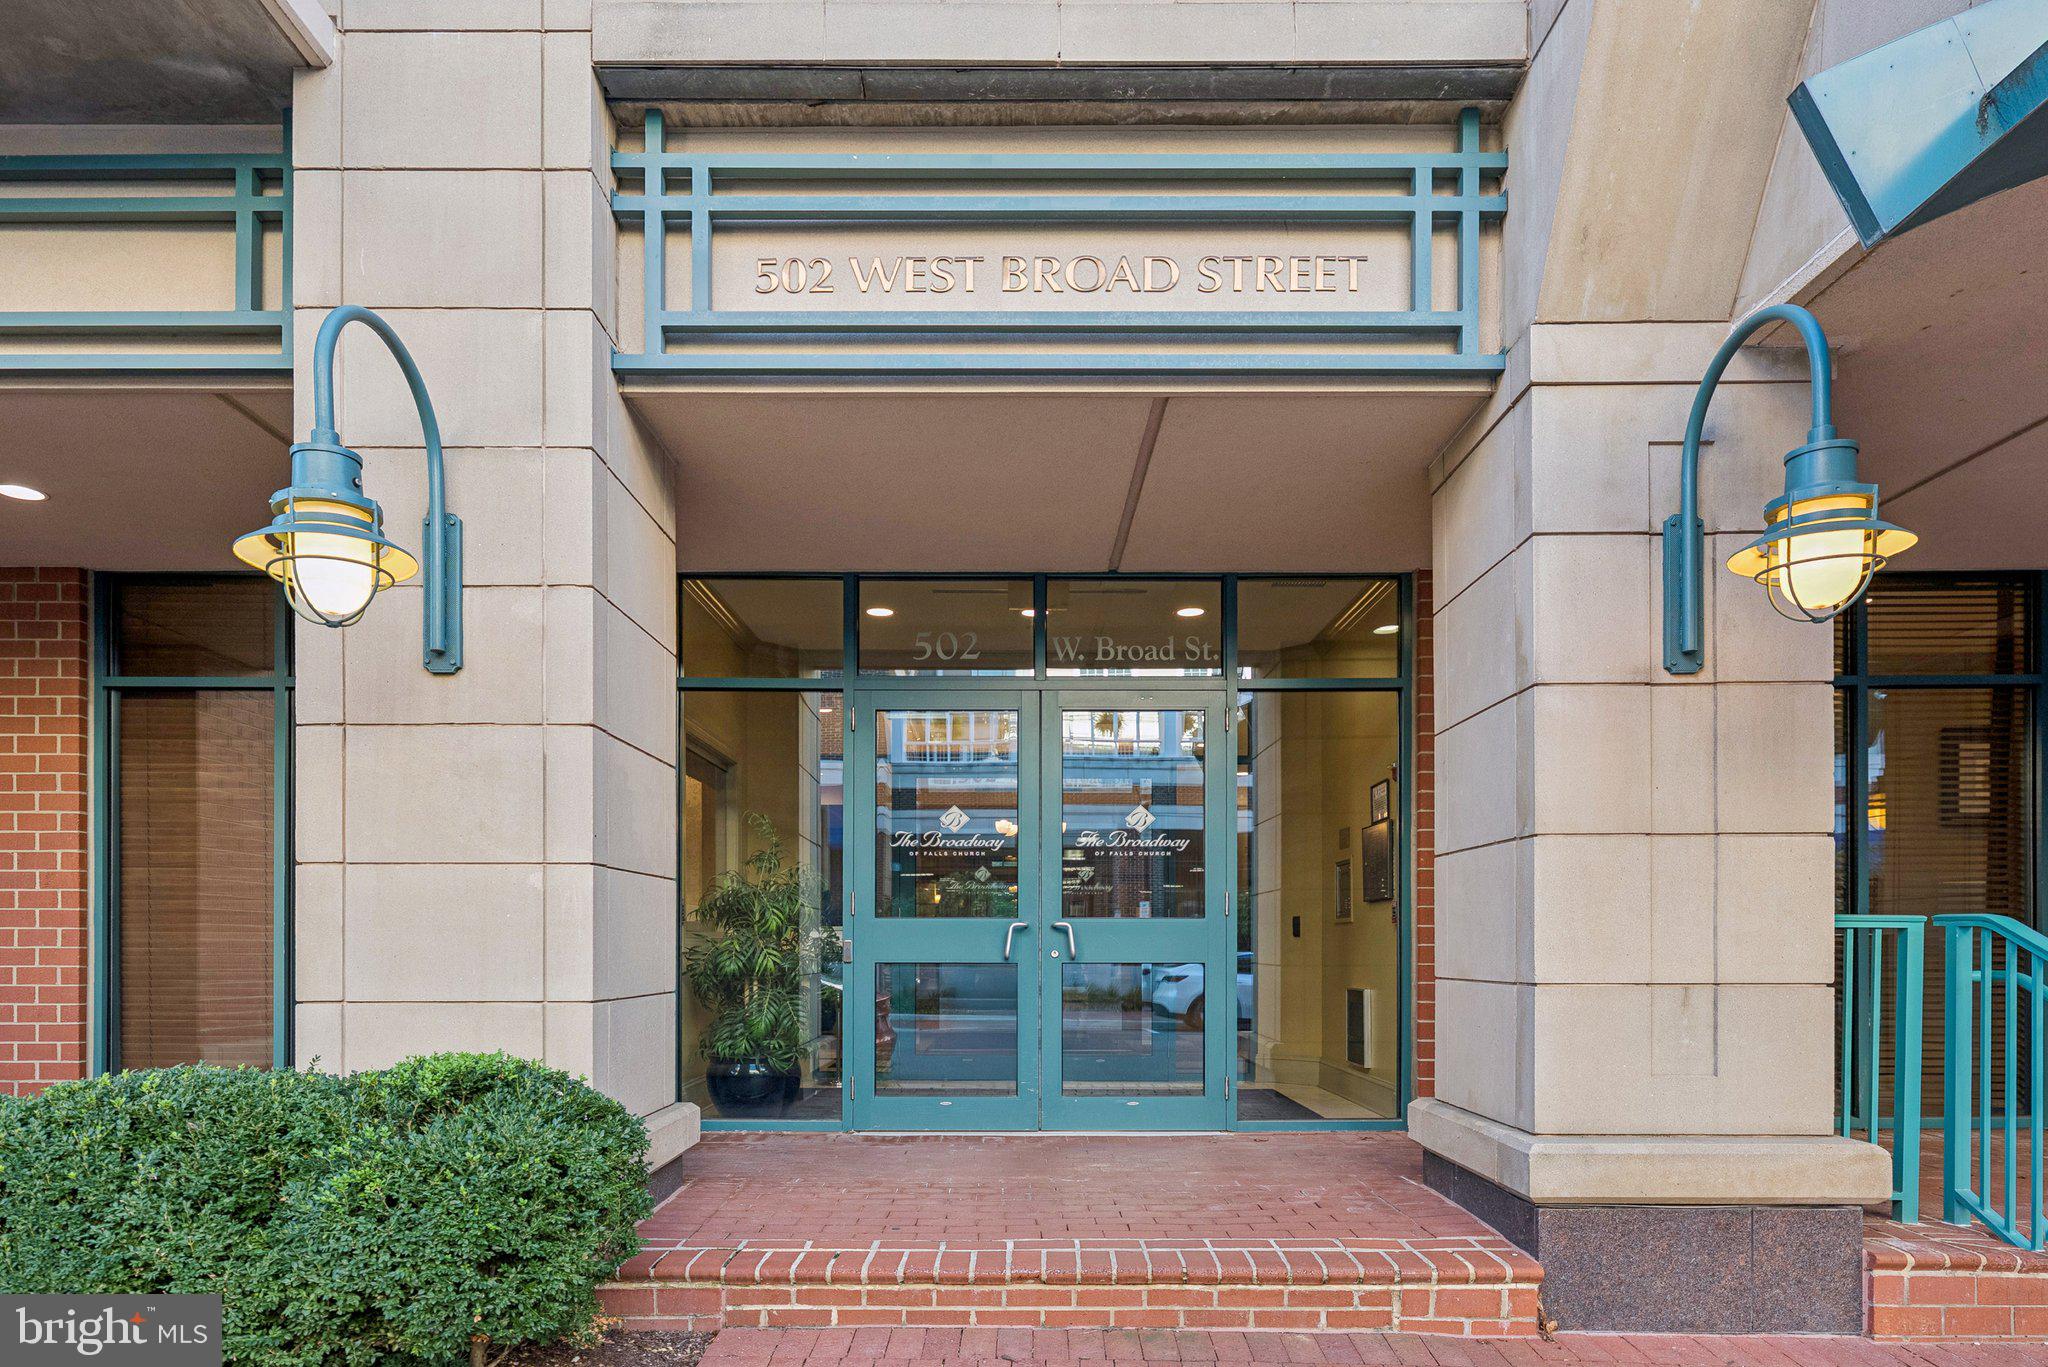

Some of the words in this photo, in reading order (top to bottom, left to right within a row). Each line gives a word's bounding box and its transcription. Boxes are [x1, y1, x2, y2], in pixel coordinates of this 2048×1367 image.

[755, 257, 834, 294] 502
[849, 257, 984, 293] WEST
[1001, 256, 1180, 293] BROAD
[1197, 256, 1368, 293] STREET
[913, 632, 981, 661] 502
[1052, 637, 1085, 661] W.
[1095, 636, 1175, 661] Broad
[1185, 636, 1220, 661] St.
[889, 830, 919, 847] The
[920, 830, 1004, 851] Broadway
[1075, 830, 1104, 847] The
[1106, 830, 1190, 851] Broadway
